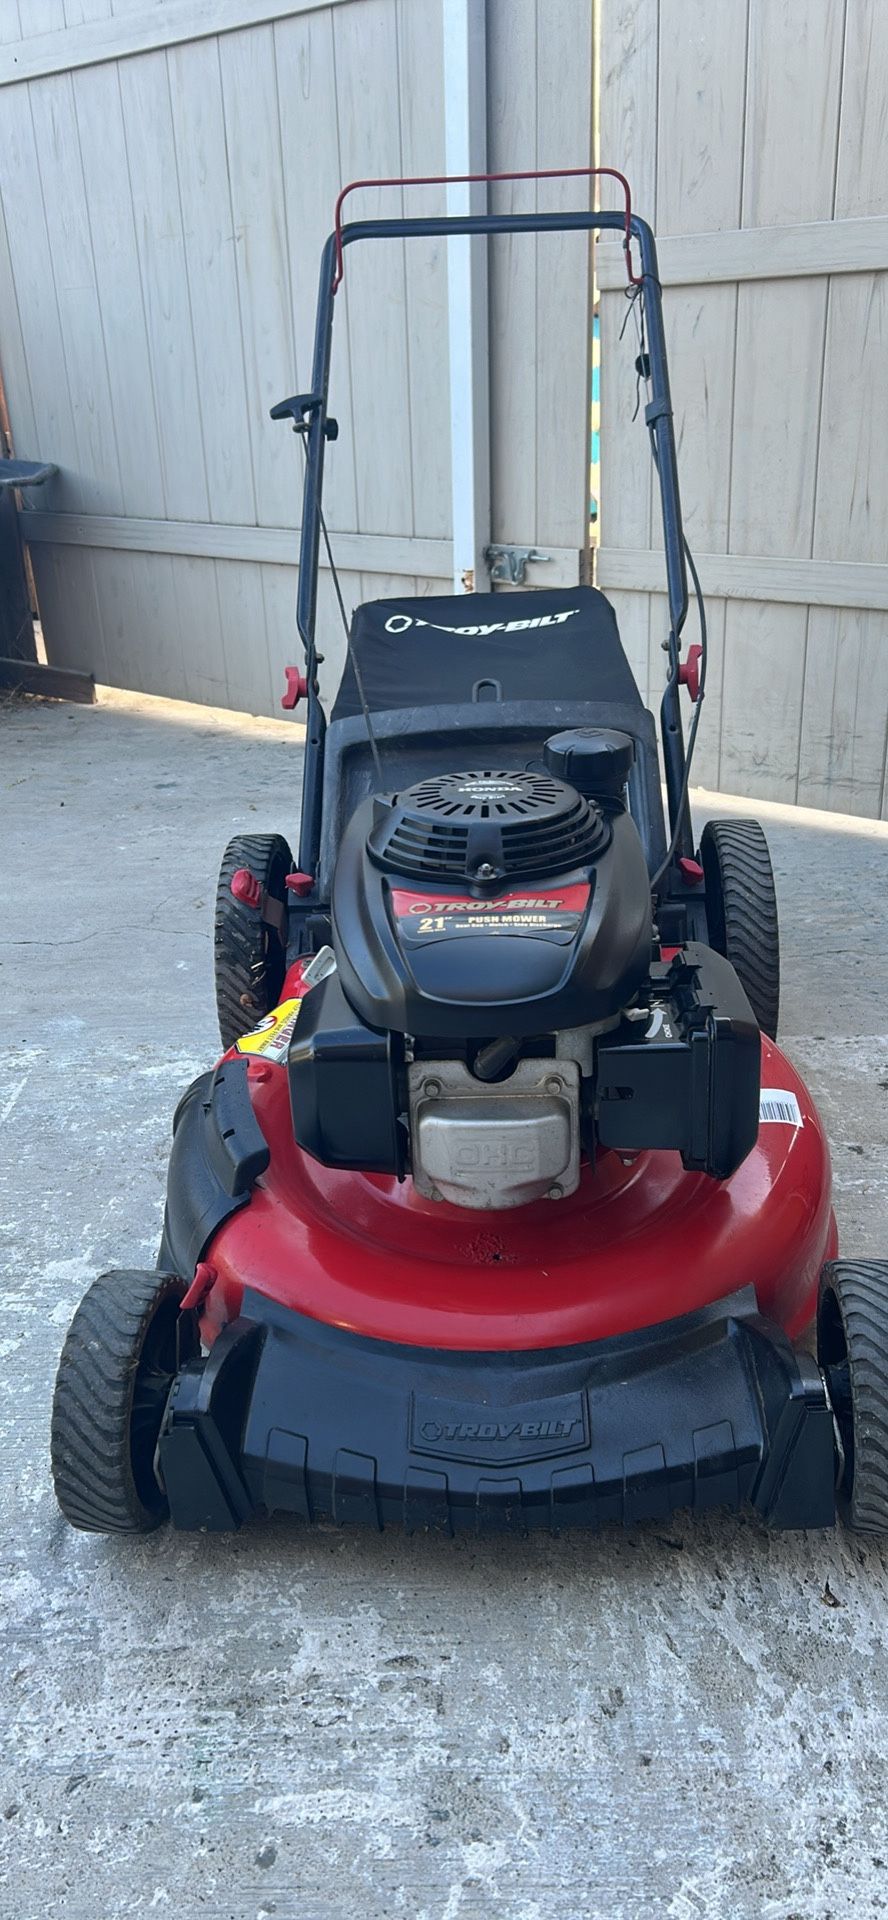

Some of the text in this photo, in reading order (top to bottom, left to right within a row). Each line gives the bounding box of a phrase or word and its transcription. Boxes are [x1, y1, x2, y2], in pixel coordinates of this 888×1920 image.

[415, 610, 577, 636] OY-BILT
[434, 899, 564, 912] TROY-BILT
[468, 916, 500, 924] PUSH
[501, 915, 547, 923] MOWER
[457, 1144, 535, 1165] OHC
[444, 1419, 577, 1441] TROY-BILT
